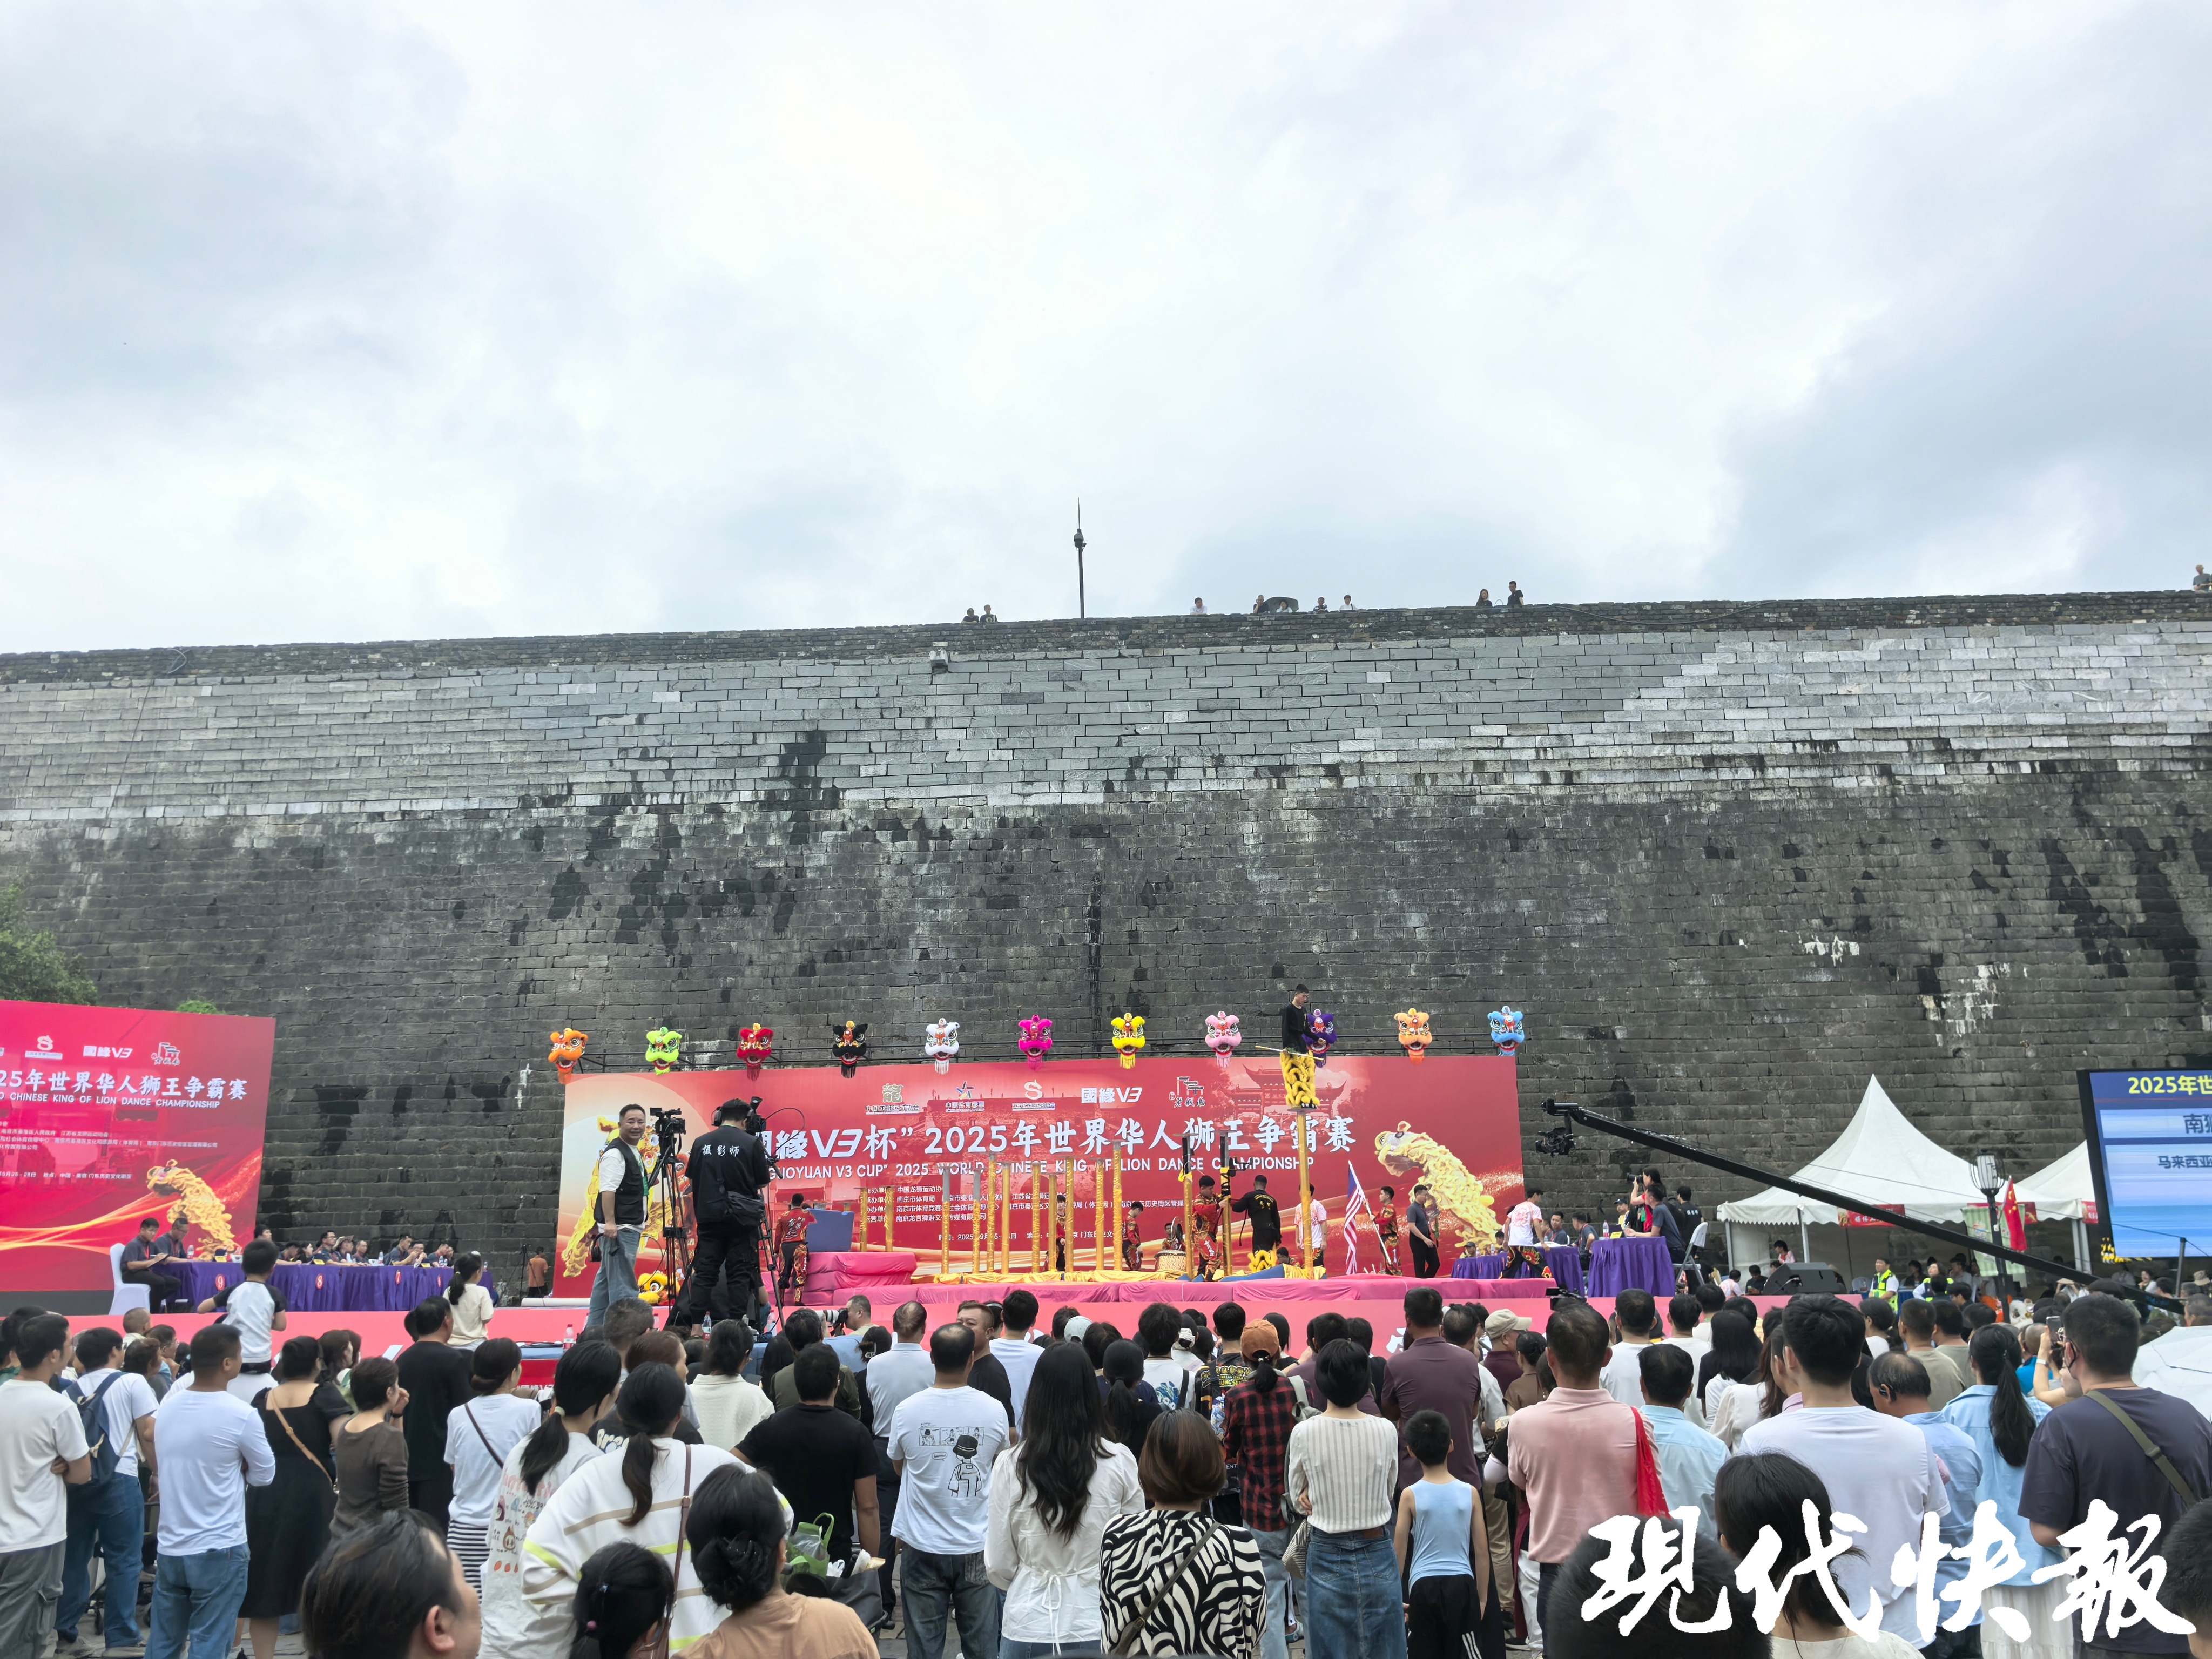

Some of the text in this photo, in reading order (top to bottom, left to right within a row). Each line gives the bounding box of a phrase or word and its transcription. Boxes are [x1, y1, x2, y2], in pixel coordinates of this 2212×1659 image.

[10, 1092, 48, 1102] CHINESE
[53, 1094, 75, 1103] KING
[79, 1095, 92, 1103] OF
[96, 1096, 117, 1104] LION
[122, 1097, 151, 1105] DANCE
[156, 1098, 220, 1108] CHAMPIONSHIP
[1081, 1087, 1143, 1103] 國緣V3
[835, 1165, 852, 1178] V3
[896, 1163, 928, 1176] 2025
[1121, 1158, 1150, 1171] LION
[218, 1276, 224, 1289] 9
[317, 1274, 323, 1287] 8
